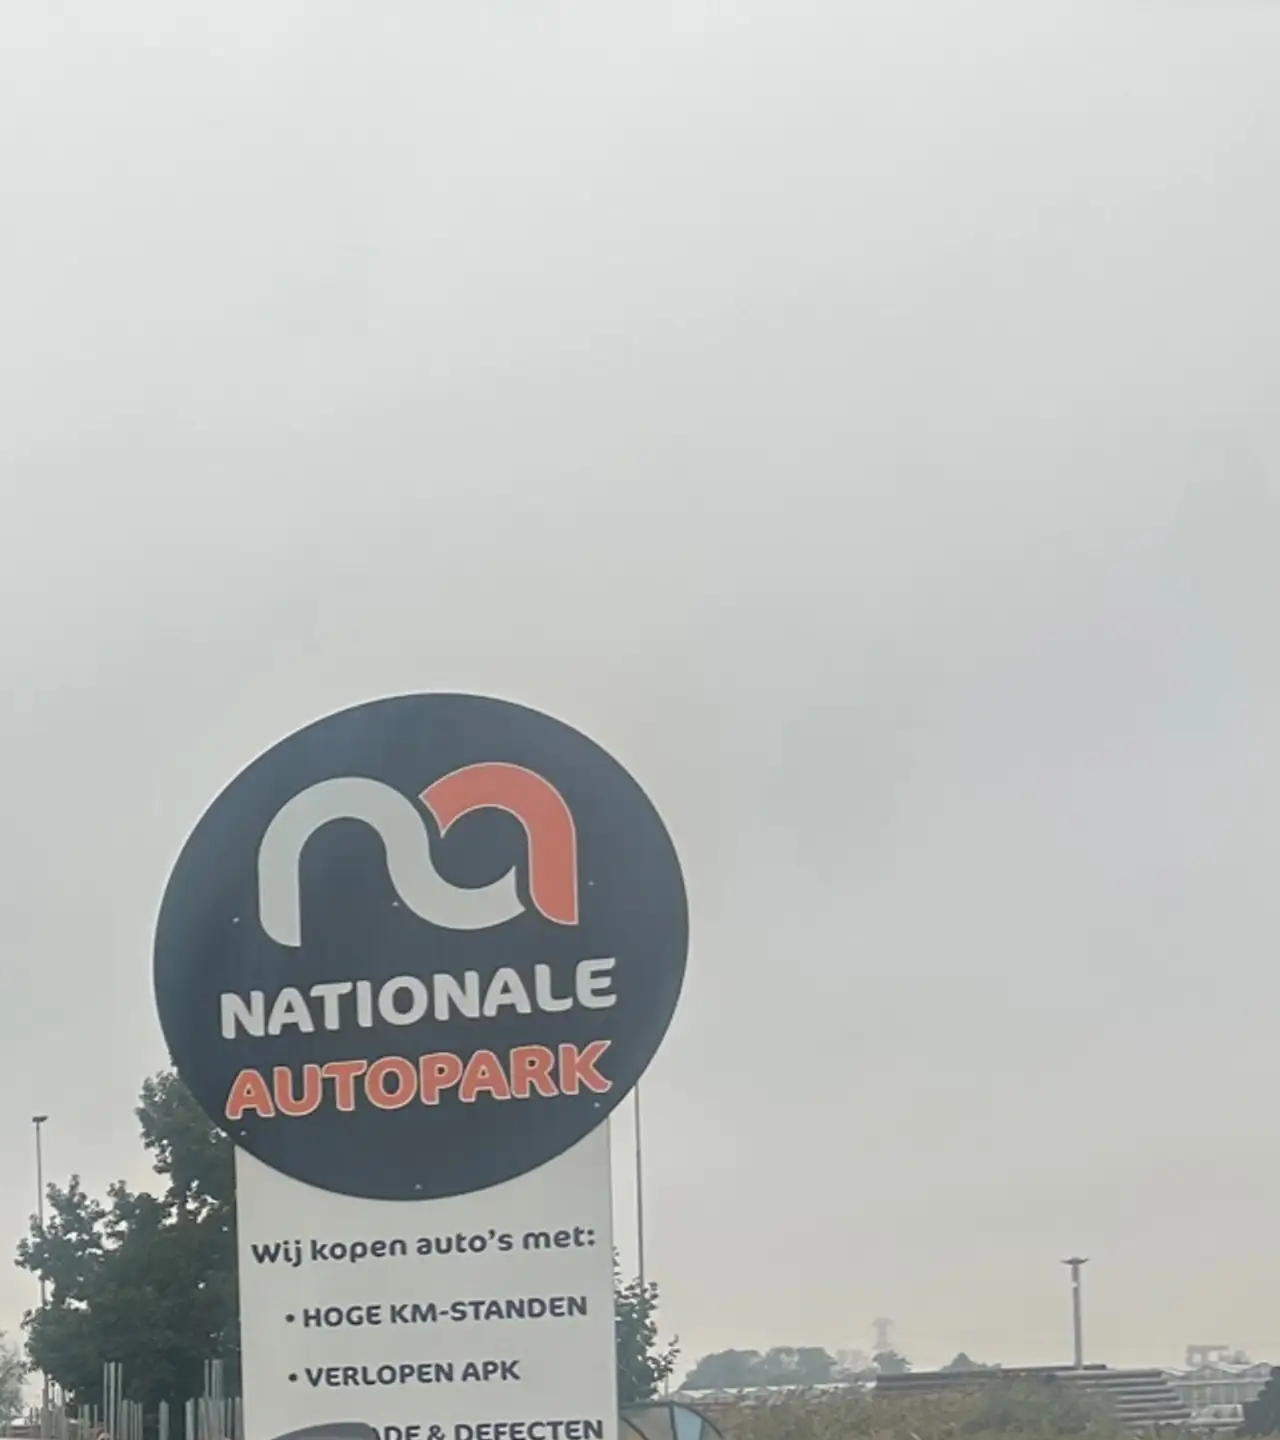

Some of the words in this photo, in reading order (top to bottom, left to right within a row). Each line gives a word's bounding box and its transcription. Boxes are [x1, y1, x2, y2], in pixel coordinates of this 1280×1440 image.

[220, 956, 617, 1040] NATIONALE
[224, 1040, 613, 1120] AUTOPARK
[251, 1240, 302, 1267] Wij
[310, 1237, 407, 1264] kopen
[522, 1226, 596, 1250] met:
[302, 1303, 382, 1328] HOGE
[389, 1295, 588, 1324] KM-STANDEN
[304, 1363, 453, 1388] VERLOPEN
[461, 1359, 521, 1383] APK
